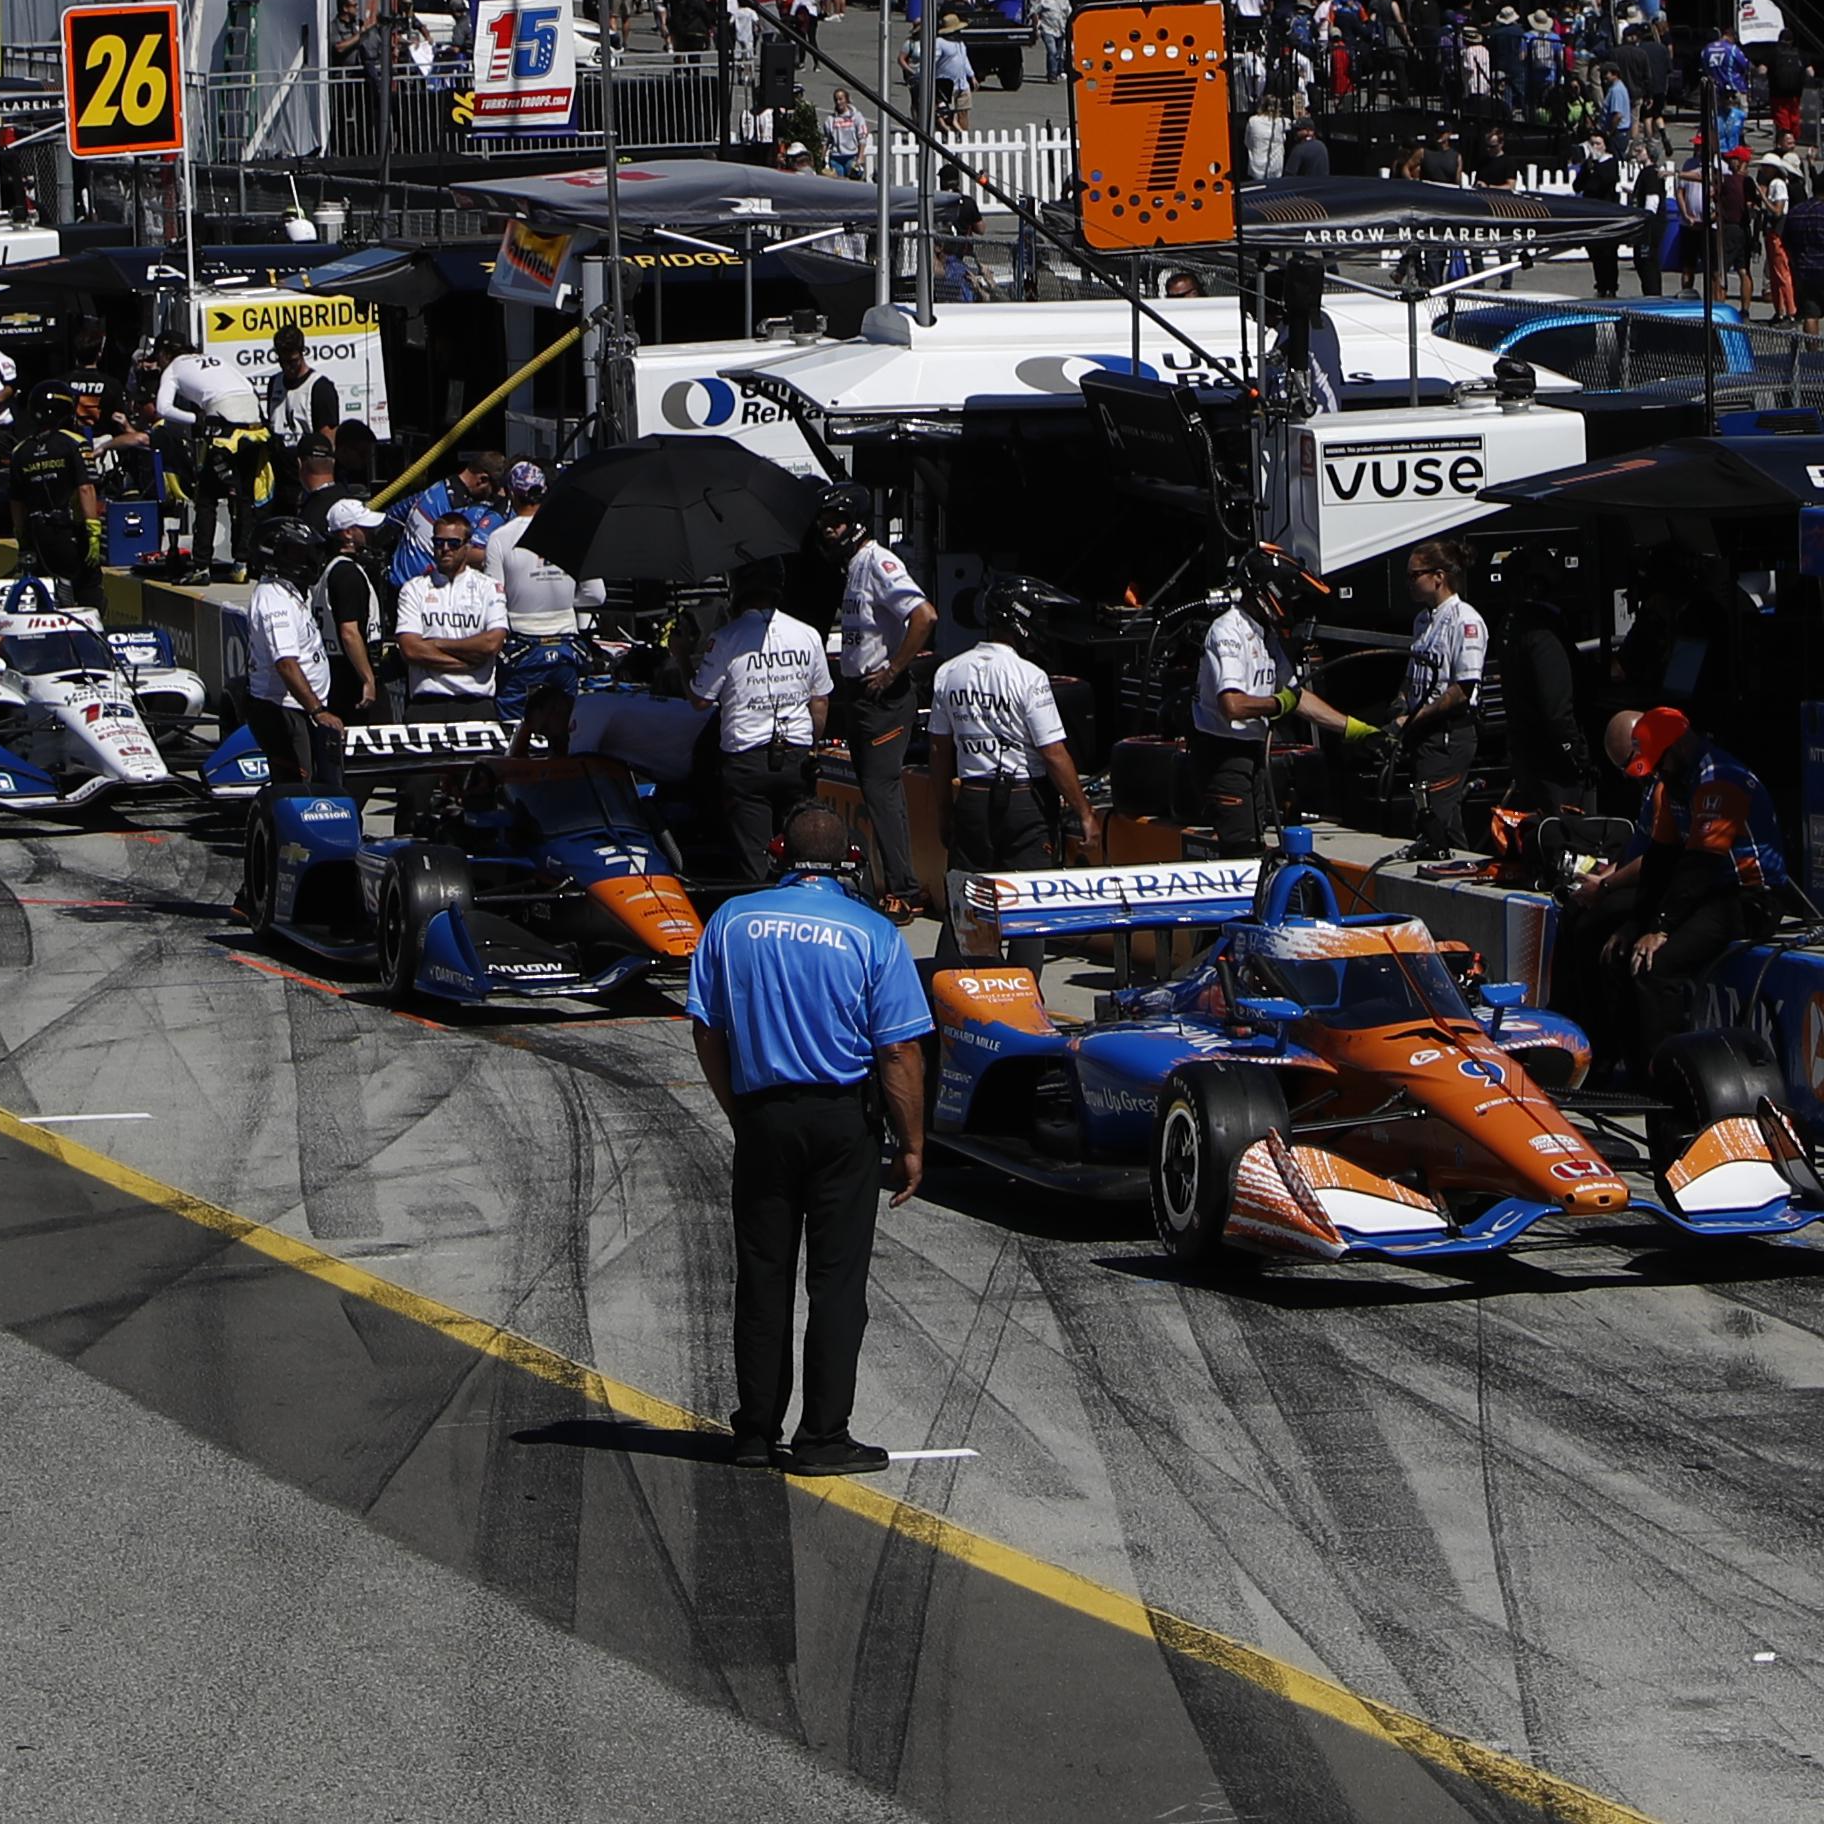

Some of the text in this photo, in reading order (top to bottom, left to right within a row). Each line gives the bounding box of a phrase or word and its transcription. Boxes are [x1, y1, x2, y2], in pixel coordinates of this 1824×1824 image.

[486, 5, 561, 82] 15
[77, 32, 167, 128] 26
[1107, 69, 1199, 192] 7
[1304, 225, 1538, 245] ARROW McLAREN SP
[236, 342, 357, 368] GROP1001
[1324, 455, 1484, 501] vuse
[746, 650, 811, 672] ARROW
[949, 689, 1011, 713] ARROW
[302, 809, 351, 822] mission
[1029, 866, 1256, 904] PNC BANK
[746, 918, 848, 952] OFFICIAL
[486, 961, 563, 975] ARROW
[984, 977, 1031, 991] PNC
[1246, 1008, 1268, 1021] PNC
[975, 1032, 1002, 1053] MILLE
[1458, 1058, 1506, 1088] 9
